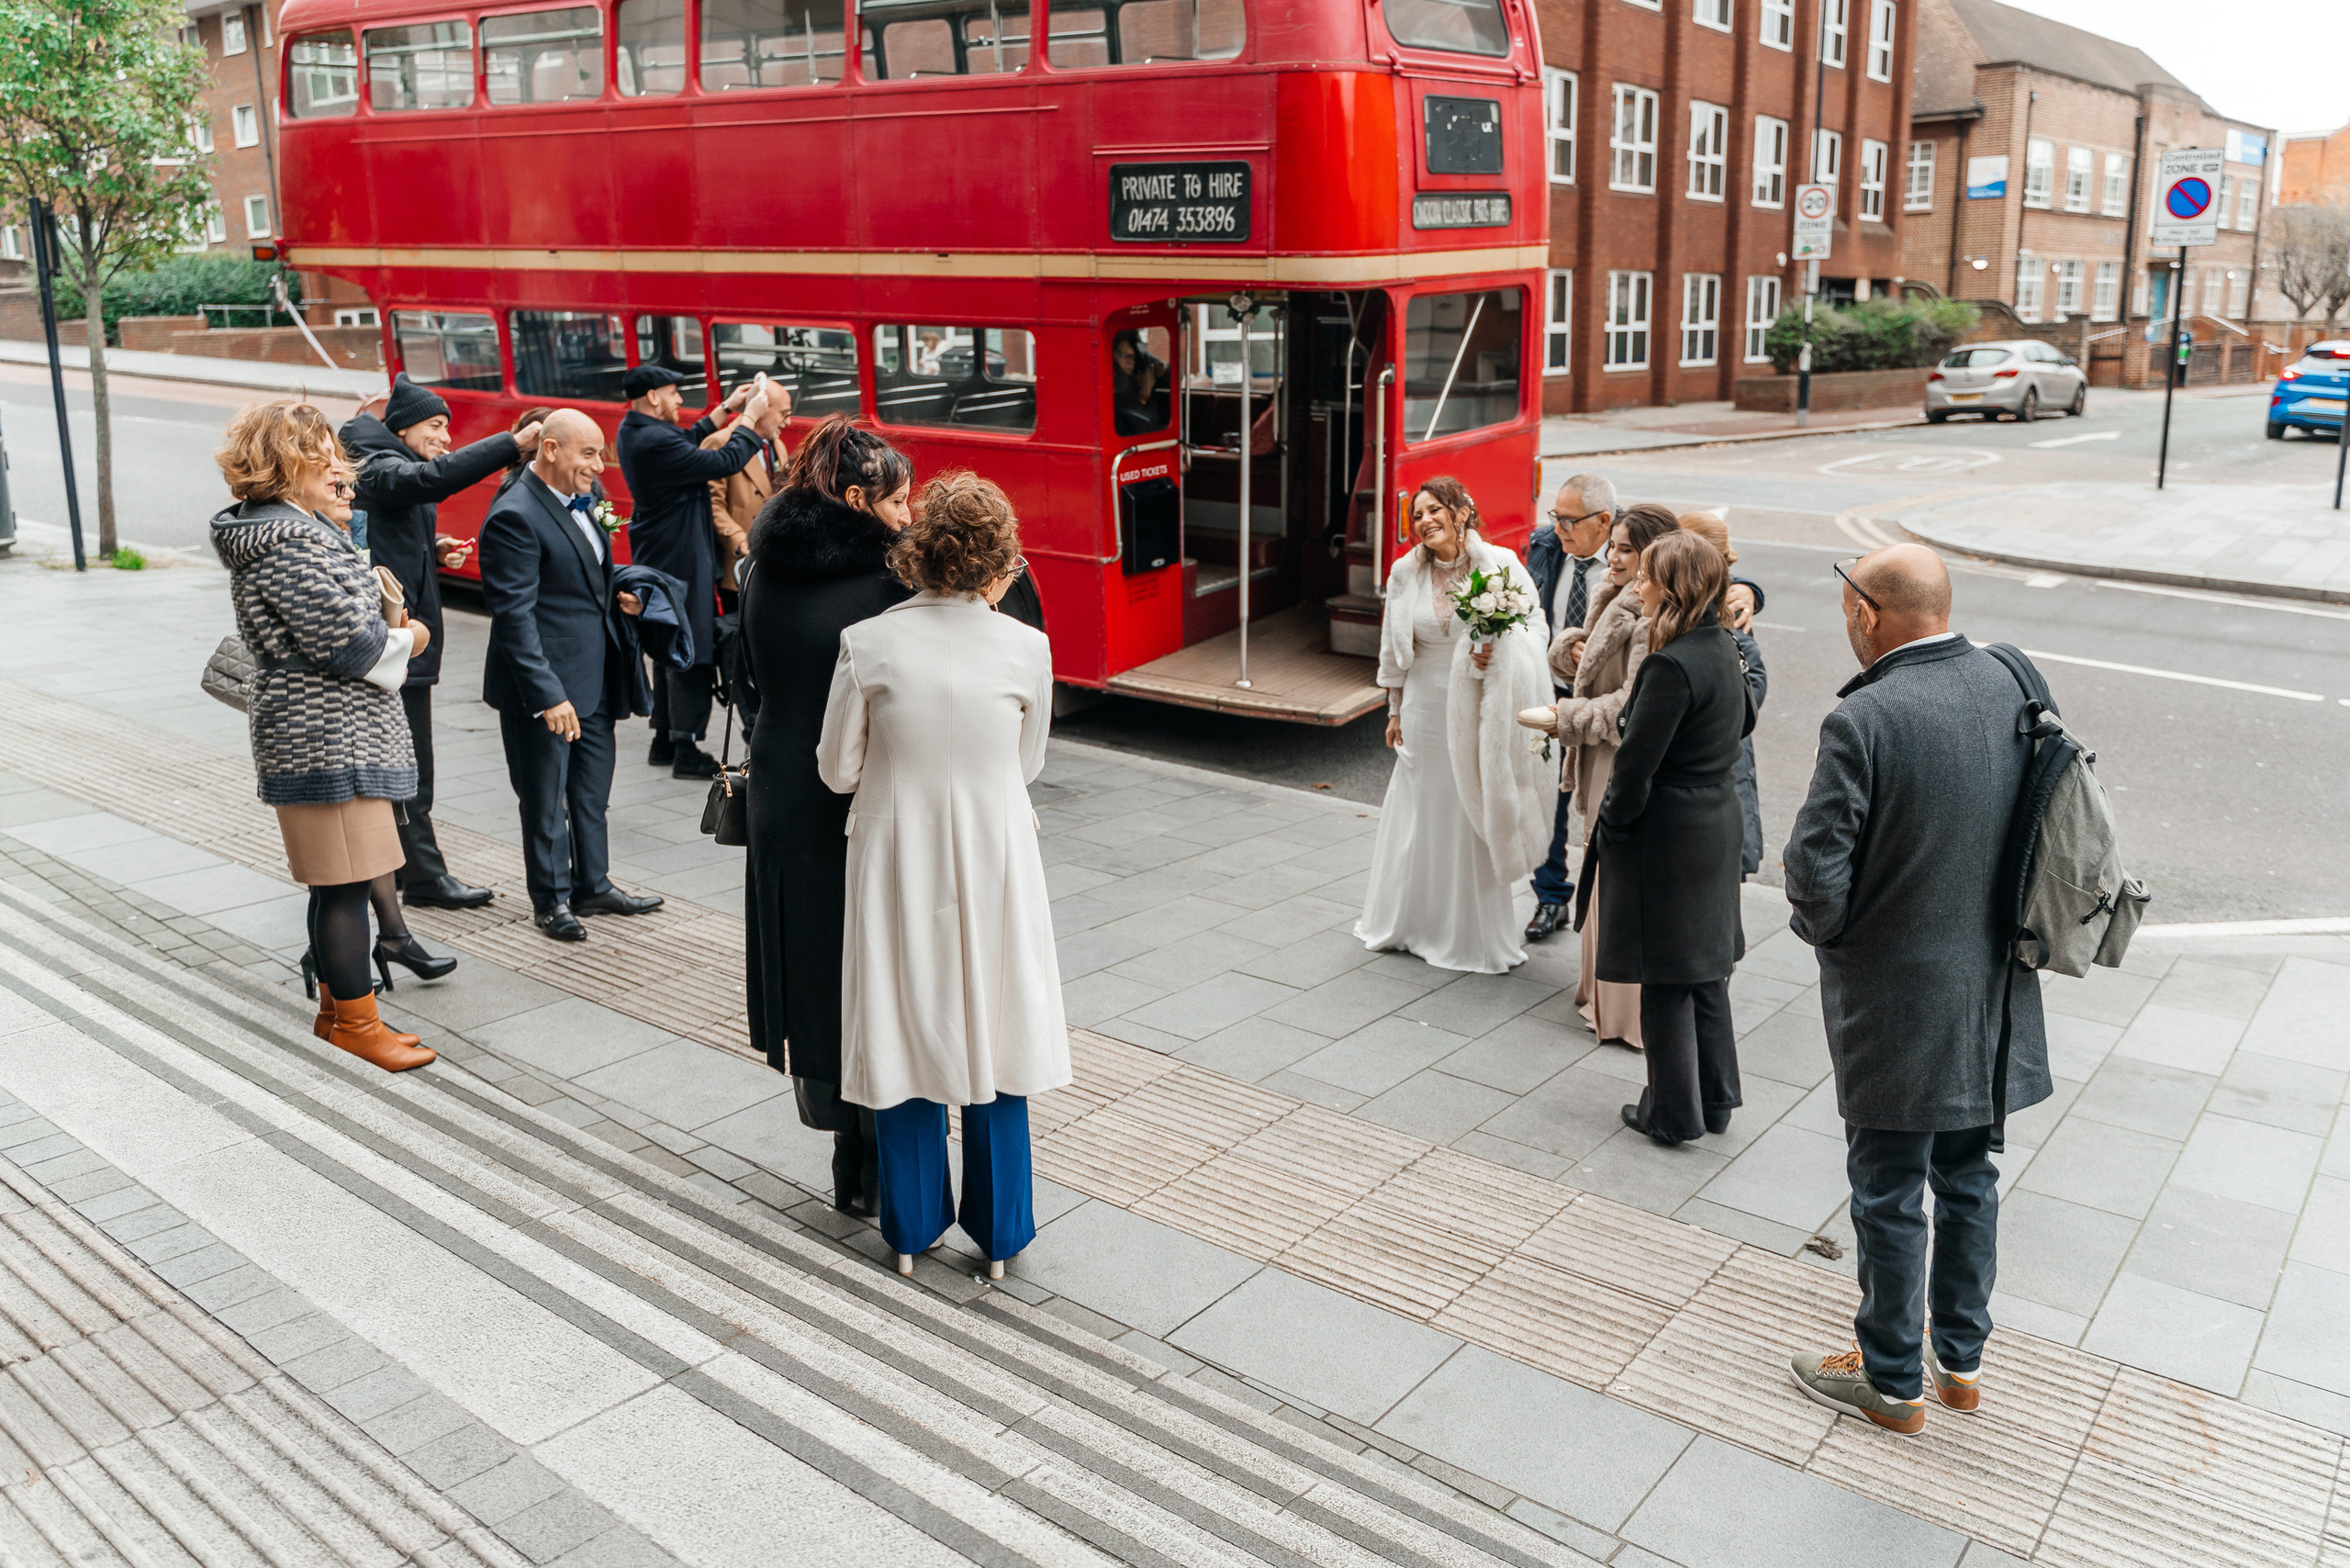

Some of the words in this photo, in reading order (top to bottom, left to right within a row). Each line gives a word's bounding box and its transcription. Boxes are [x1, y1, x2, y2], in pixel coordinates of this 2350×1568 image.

[2165, 163, 2198, 174] ZONE
[1122, 174, 1176, 200] PRIVATE
[1183, 174, 1202, 198] TO
[1209, 173, 1243, 198] HIRE
[1806, 196, 1826, 209] 20
[1128, 208, 1169, 232] 01474
[1176, 206, 1236, 232] 353896
[1120, 470, 1140, 481] USED
[1142, 465, 1168, 476] TICKETS
